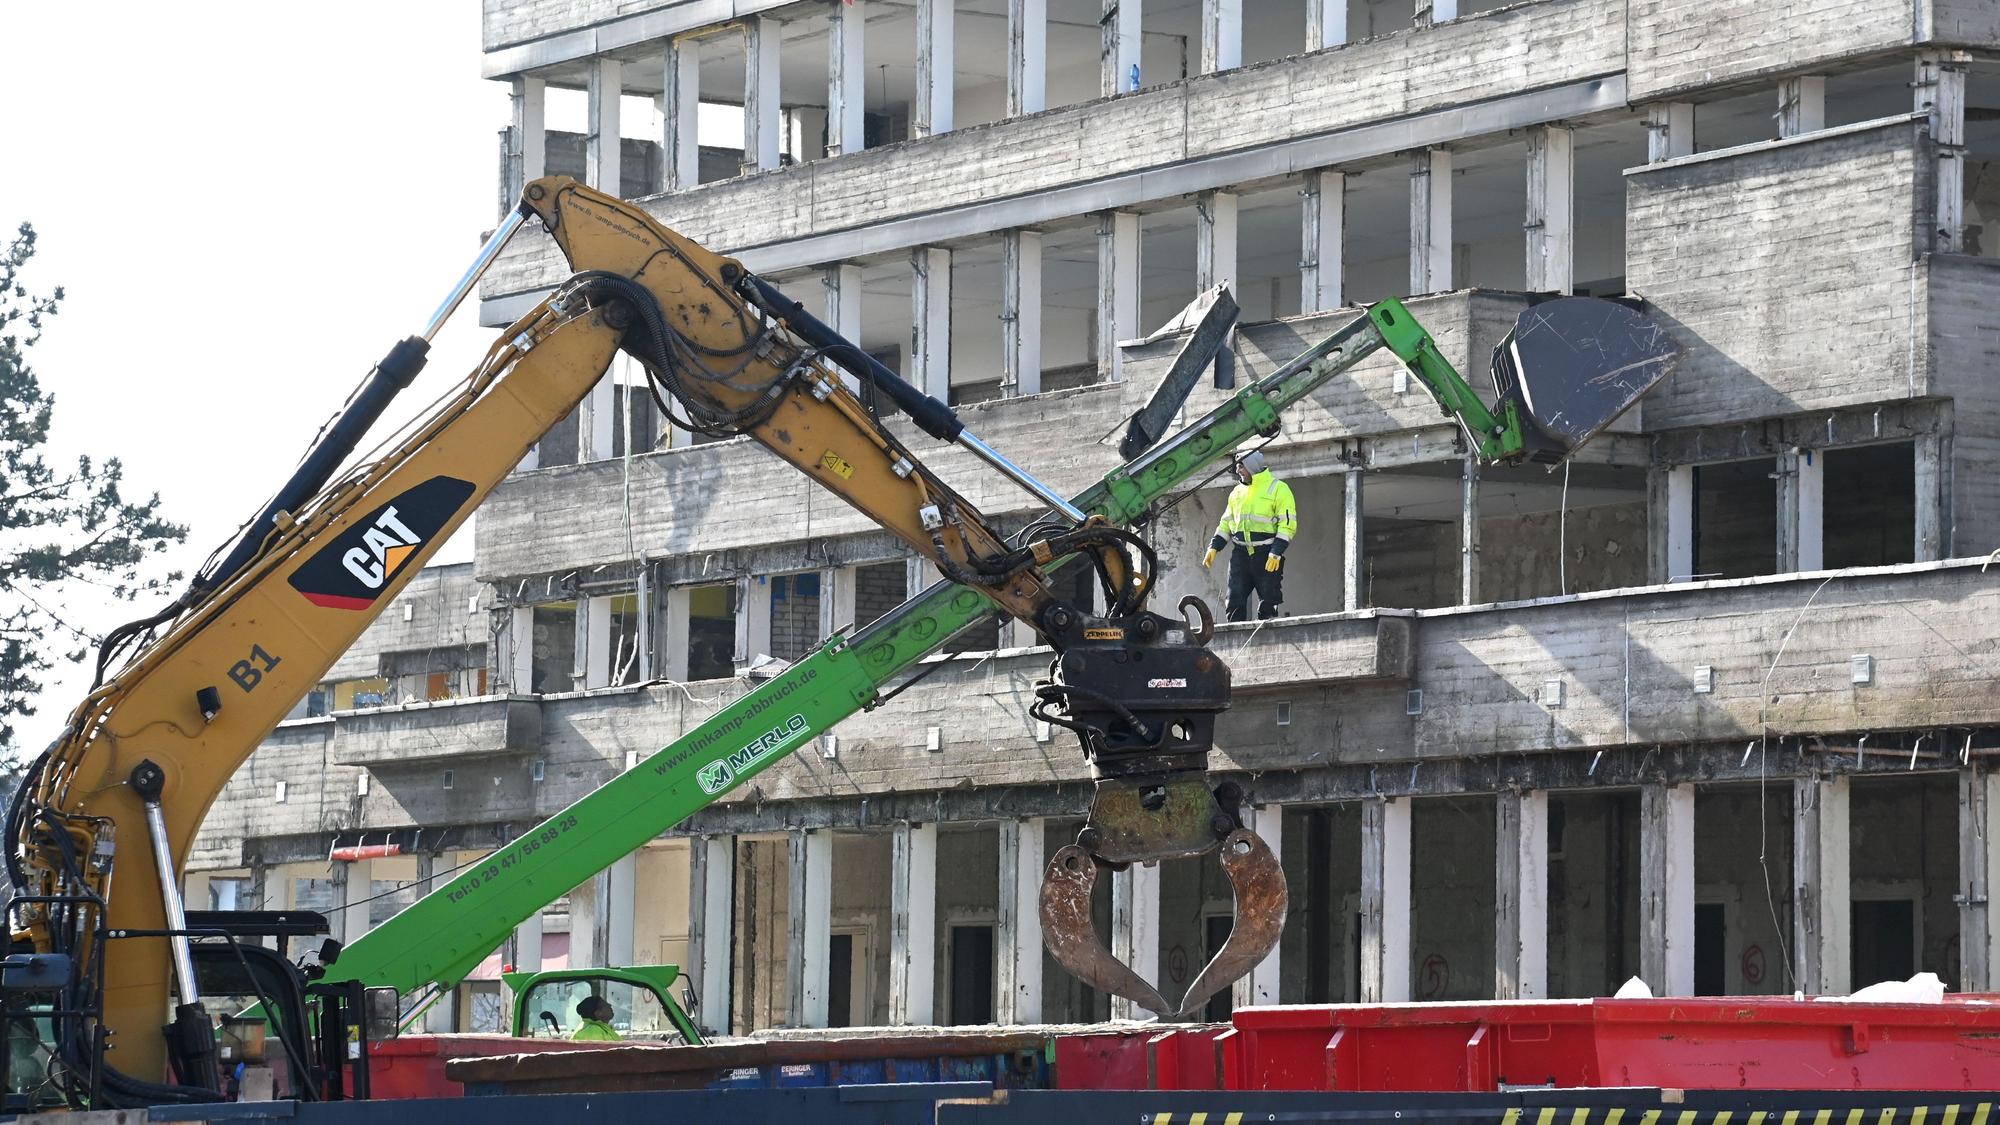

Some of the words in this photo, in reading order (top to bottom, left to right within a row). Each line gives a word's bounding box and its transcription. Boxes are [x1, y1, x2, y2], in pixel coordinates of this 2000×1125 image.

[342, 505, 422, 589] CAT
[1085, 630, 1122, 638] ZEPPELIN
[227, 643, 282, 694] B1
[653, 668, 818, 777] www.linkamp-abbruch.de
[729, 713, 806, 770] MERLO
[481, 865, 500, 883] 29
[541, 827, 559, 845] 88
[560, 815, 578, 833] 28
